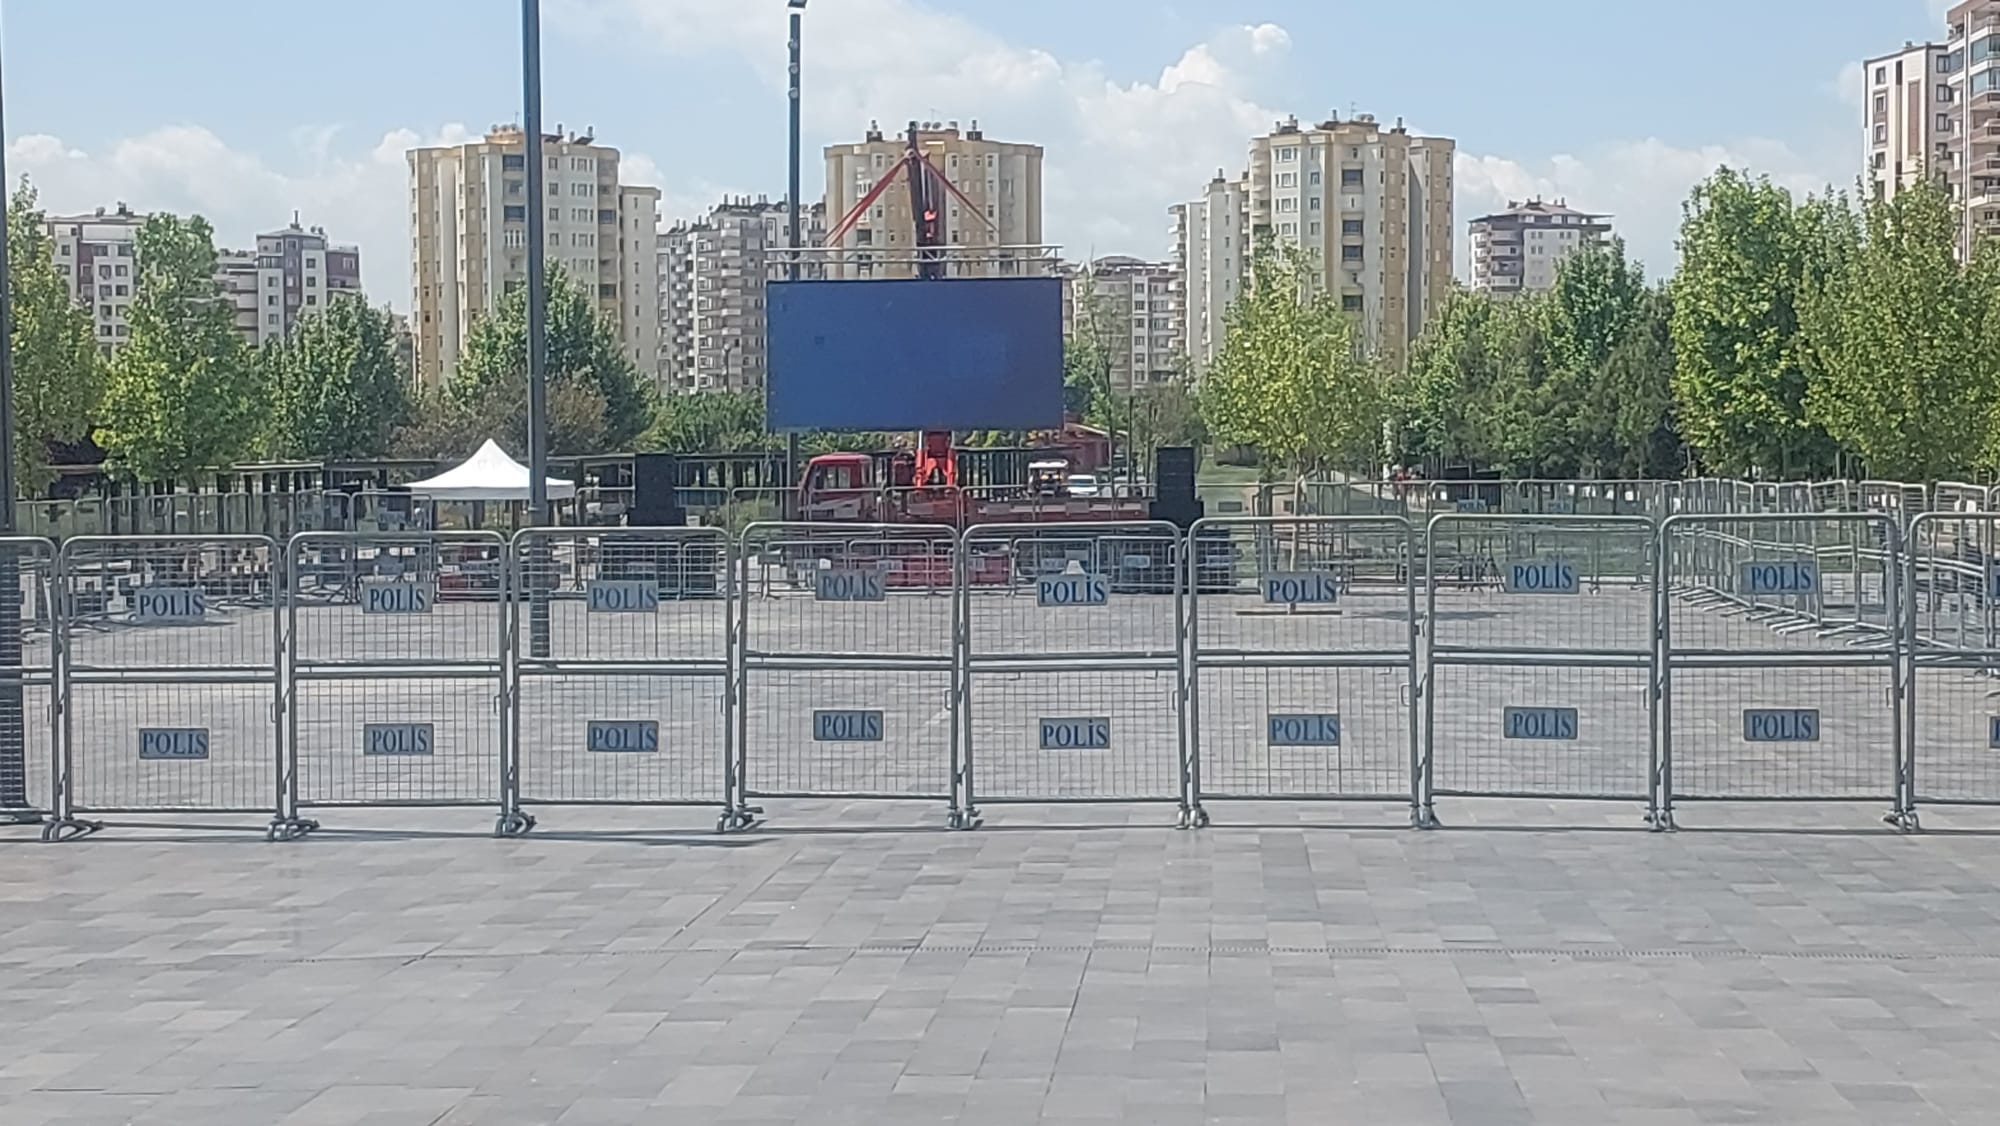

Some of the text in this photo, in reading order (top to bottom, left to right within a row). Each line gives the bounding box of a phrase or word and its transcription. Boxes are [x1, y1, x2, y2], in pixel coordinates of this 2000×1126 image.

[822, 571, 879, 599] POLİS
[1040, 573, 1106, 603] POLİS
[1270, 573, 1336, 601] POLİS
[1513, 561, 1573, 589] POLİS
[1751, 563, 1811, 589] POLİS
[139, 587, 205, 616] POLİS
[370, 584, 425, 612] POLİS
[592, 581, 656, 609] POLİS
[592, 722, 657, 750] POLİS
[821, 711, 878, 738] POLİS
[1043, 719, 1107, 746] POLİS
[1272, 714, 1337, 741] POLİS
[1512, 709, 1571, 737] POLİS
[1752, 710, 1812, 738] POLİS
[143, 727, 207, 754] POLİS
[371, 724, 427, 752] POLİS
